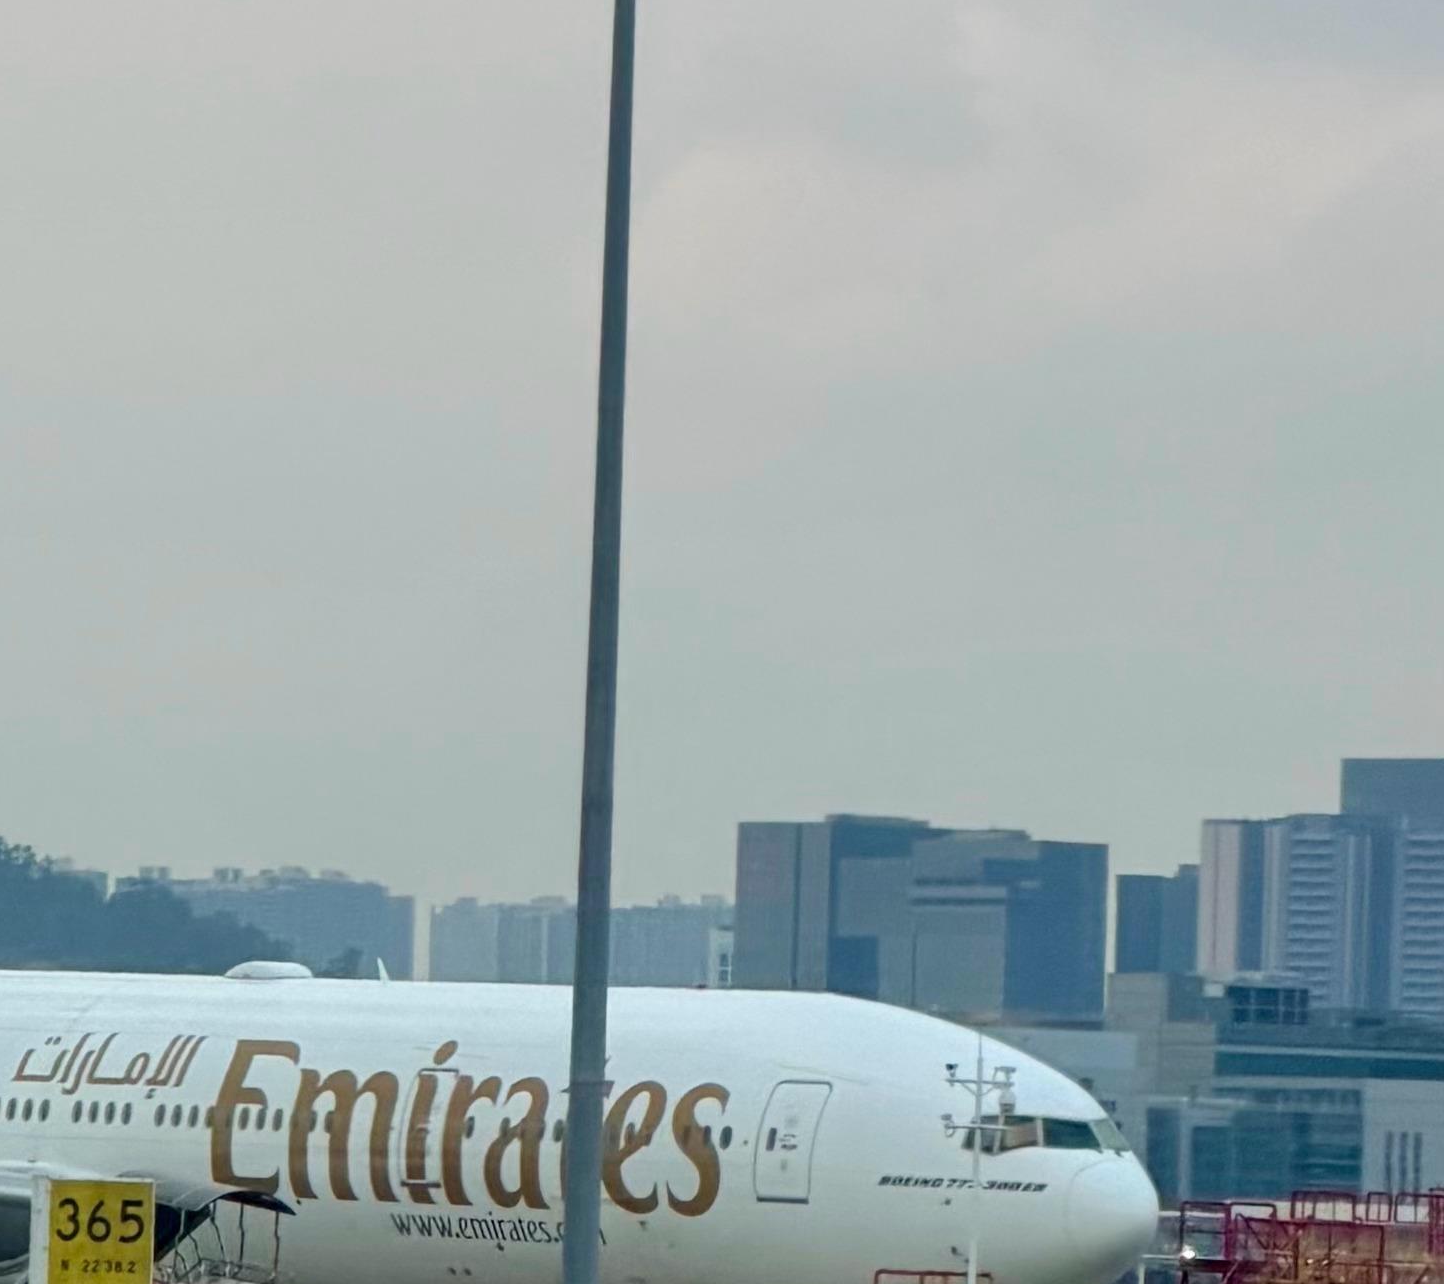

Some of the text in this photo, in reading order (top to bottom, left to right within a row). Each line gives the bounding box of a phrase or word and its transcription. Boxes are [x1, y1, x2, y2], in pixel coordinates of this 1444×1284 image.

[11, 1031, 209, 1099] الإمارات
[210, 1039, 731, 1217] Emiraes
[877, 1175, 945, 1188] BOEING
[56, 1197, 145, 1244] 365
[390, 1211, 607, 1246] www.emirates.c
